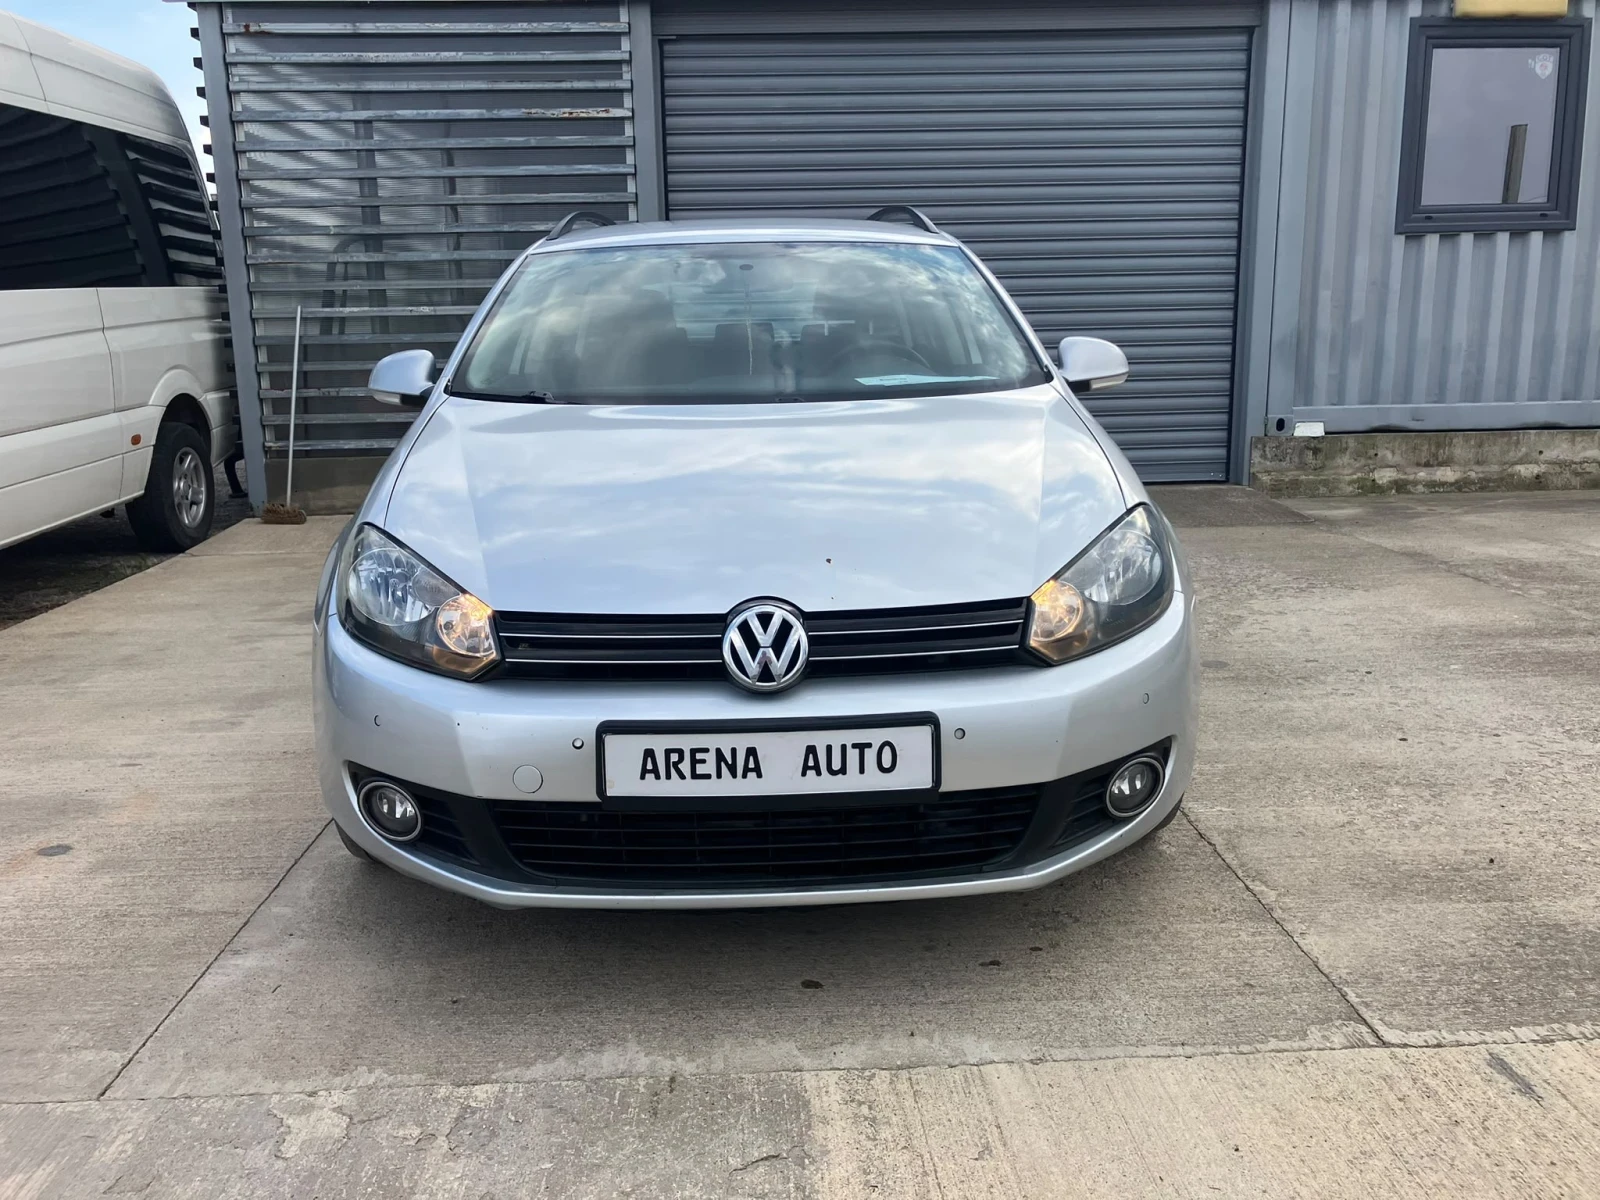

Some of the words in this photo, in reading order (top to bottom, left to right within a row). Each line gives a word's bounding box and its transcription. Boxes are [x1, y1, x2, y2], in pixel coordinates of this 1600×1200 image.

[727, 607, 804, 687] VW
[639, 746, 763, 781] ARENA
[800, 740, 898, 778] AUTO
